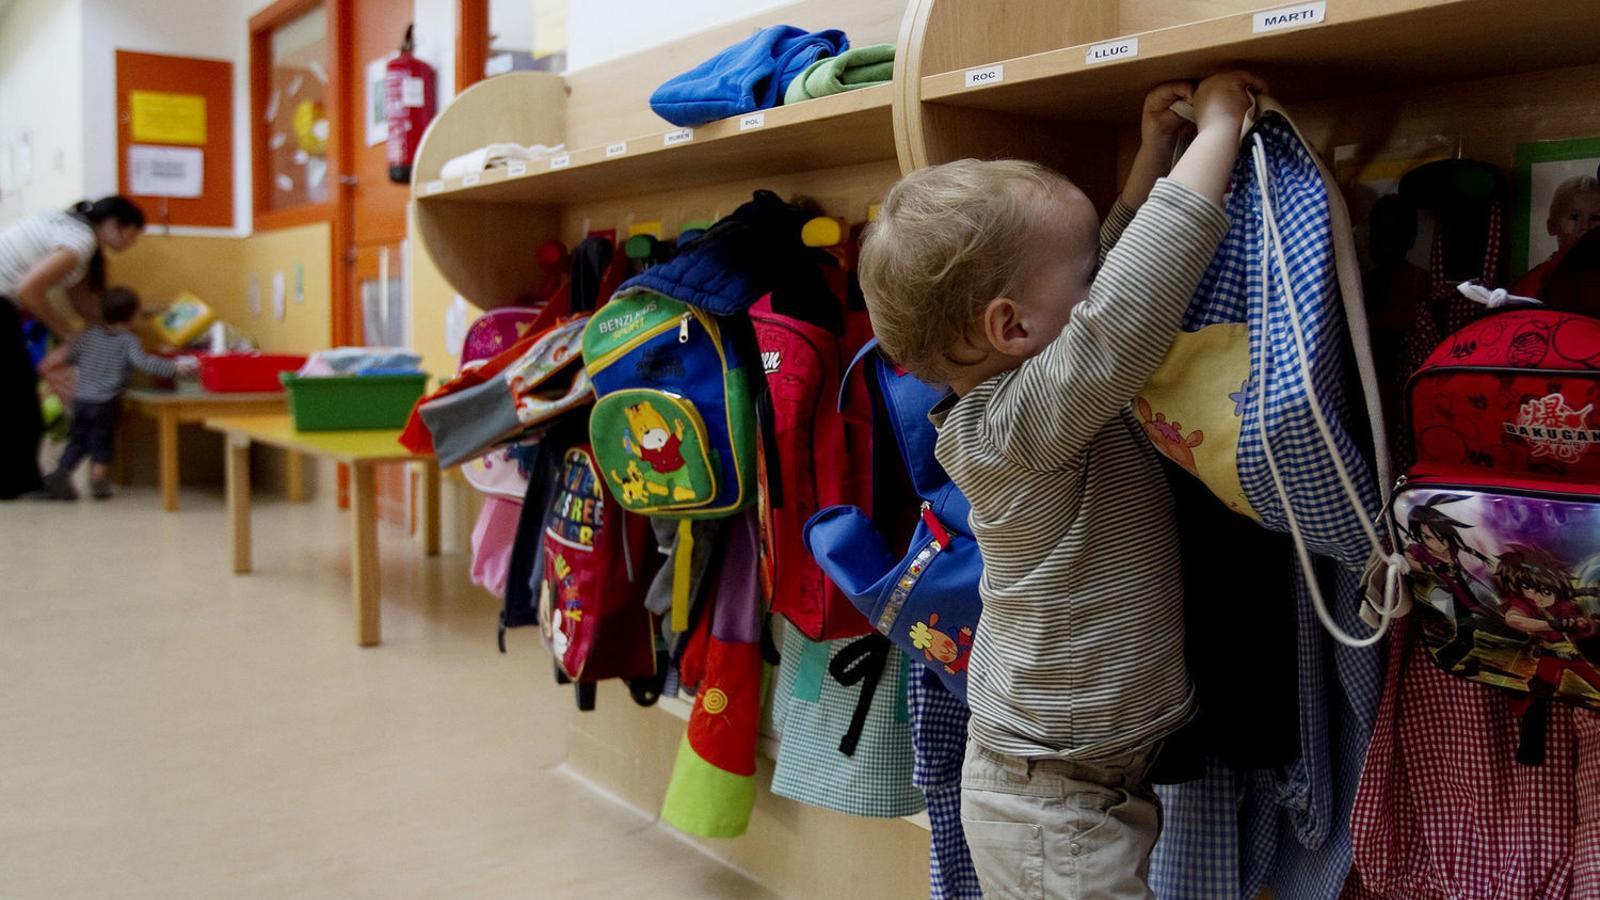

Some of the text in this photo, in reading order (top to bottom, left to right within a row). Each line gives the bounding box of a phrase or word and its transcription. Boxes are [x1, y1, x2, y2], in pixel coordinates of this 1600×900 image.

[1264, 9, 1314, 27] MARTI
[1094, 44, 1129, 59] LLUC
[972, 70, 996, 82] ROC
[744, 118, 760, 127] POL
[1505, 424, 1600, 442] BAKUGAN
